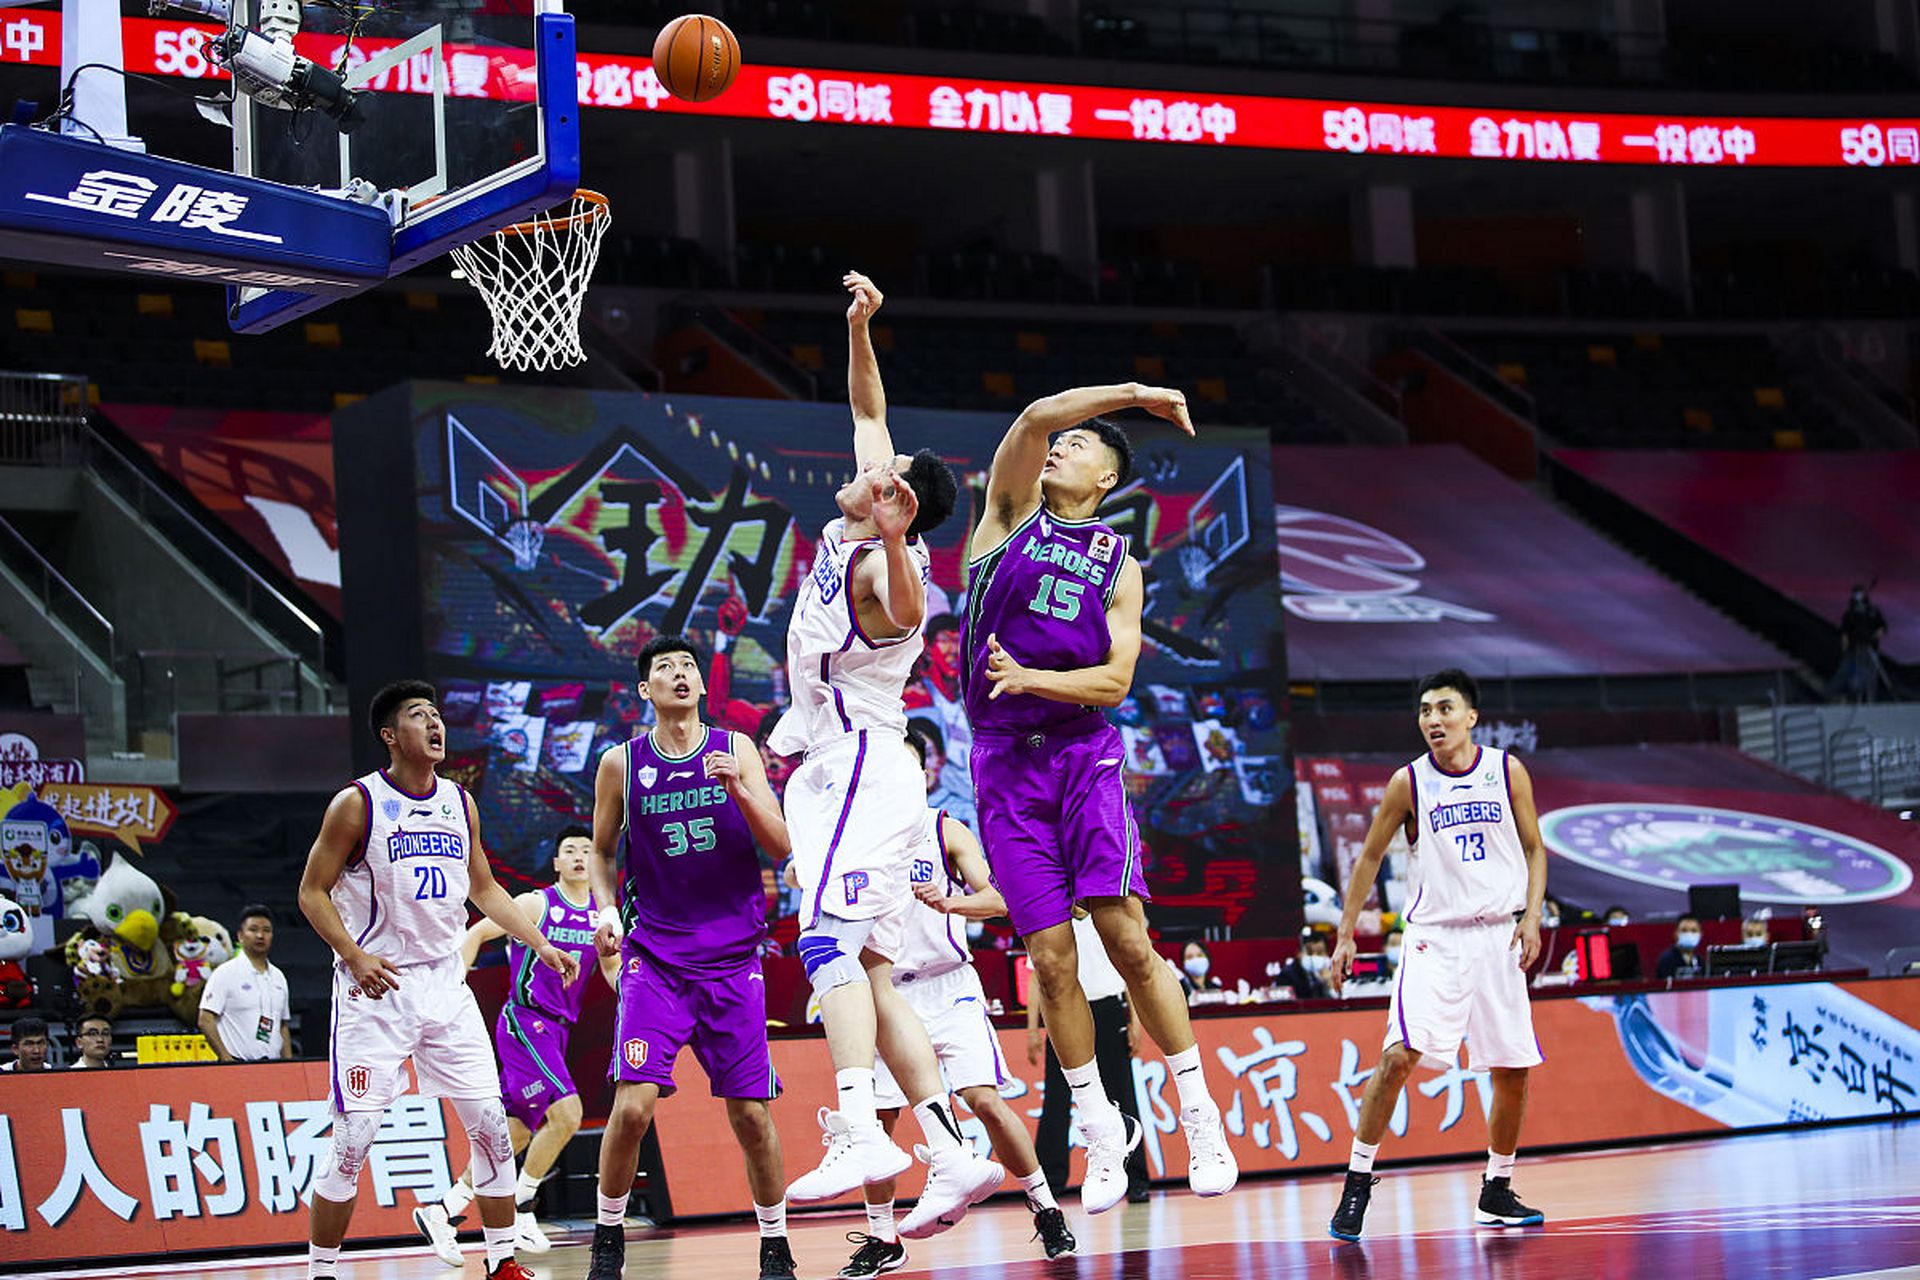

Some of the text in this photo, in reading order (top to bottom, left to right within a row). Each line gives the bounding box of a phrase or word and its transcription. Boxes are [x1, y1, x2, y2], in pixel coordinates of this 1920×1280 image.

[0, 18, 45, 61] 中
[767, 73, 893, 122] 58同城
[1096, 99, 1236, 143] 一投必中
[1323, 107, 1436, 153] 58同城
[1623, 125, 1755, 164] 一投必中
[1841, 124, 1920, 166] 58同
[68, 170, 250, 229] 金陵
[1022, 535, 1107, 586] HEROES
[1028, 574, 1086, 621] 15
[641, 785, 728, 815] HEROES
[1429, 801, 1503, 833] PIONEERS
[387, 824, 464, 863] PIONEERS
[661, 817, 716, 857] 35
[1455, 832, 1486, 862] 23
[414, 866, 447, 900] 20
[547, 925, 595, 946] HEROE
